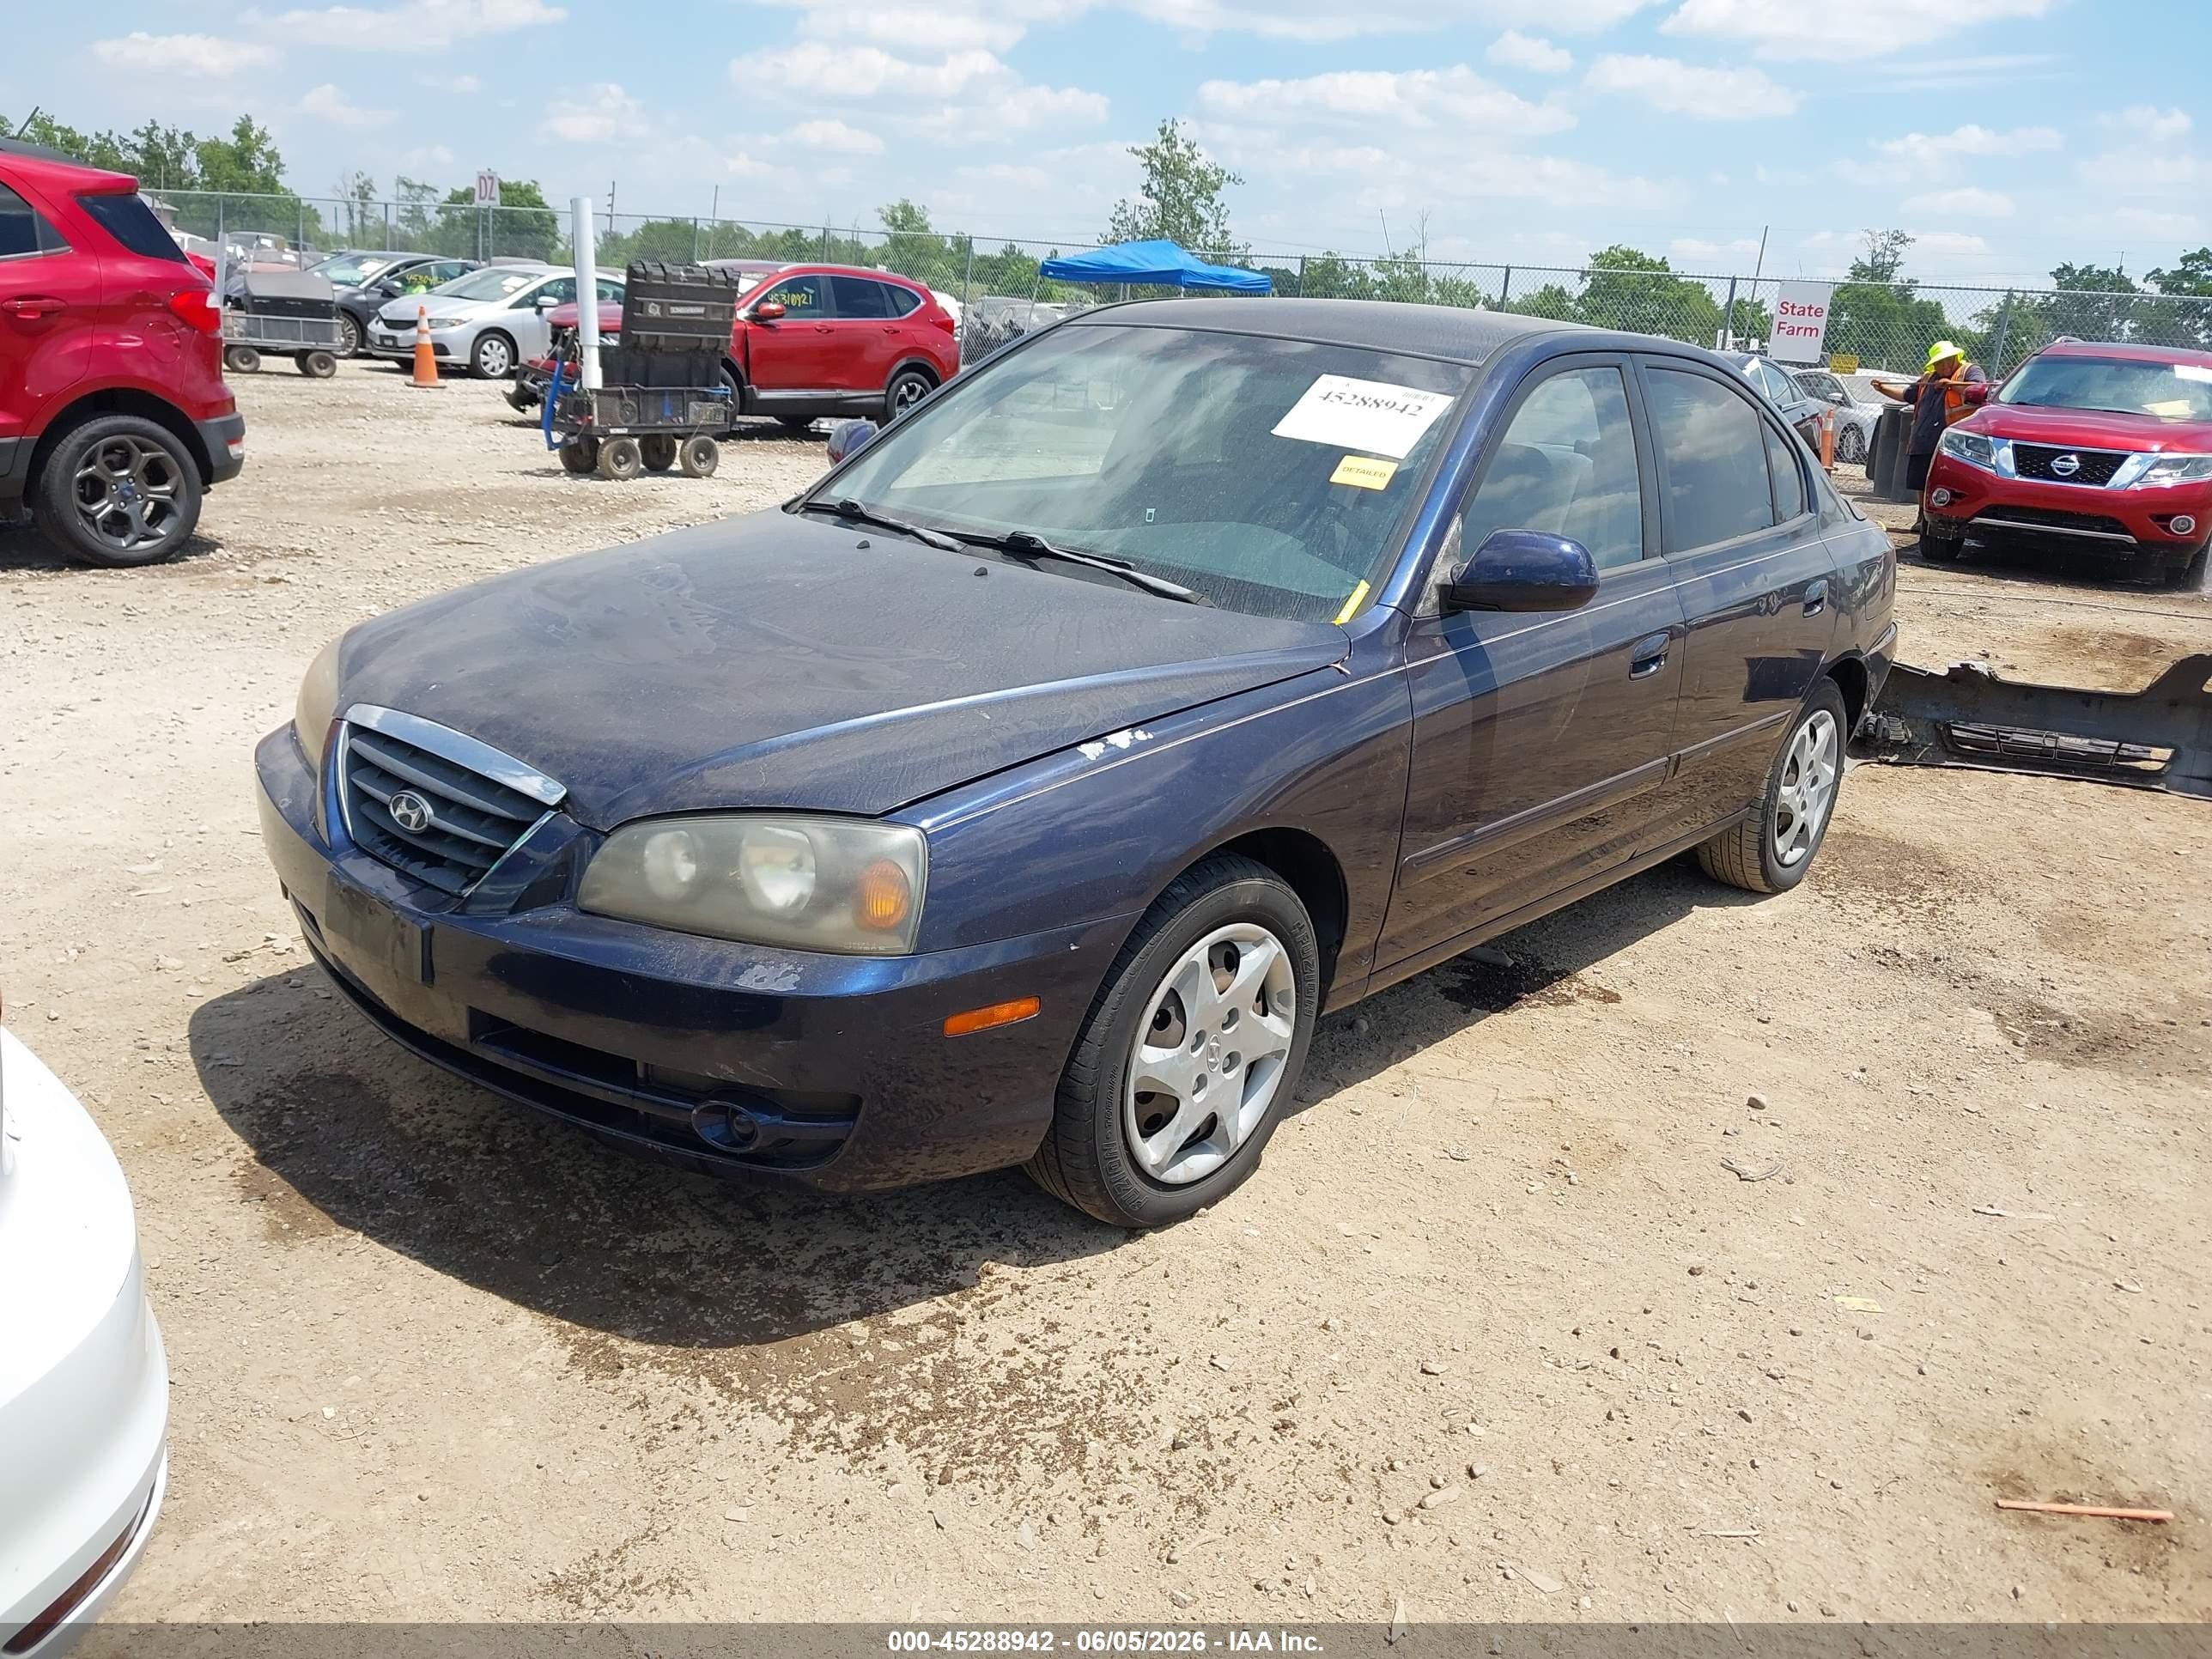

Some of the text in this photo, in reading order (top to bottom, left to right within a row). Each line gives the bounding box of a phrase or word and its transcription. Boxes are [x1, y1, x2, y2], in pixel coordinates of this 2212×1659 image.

[768, 293, 812, 307] 45310921
[1778, 301, 1824, 318] State
[1777, 321, 1819, 337] Farm
[1319, 391, 1423, 416] 45288942
[1342, 466, 1387, 478] DETAILED
[1103, 1139, 1148, 1212] FUZION
